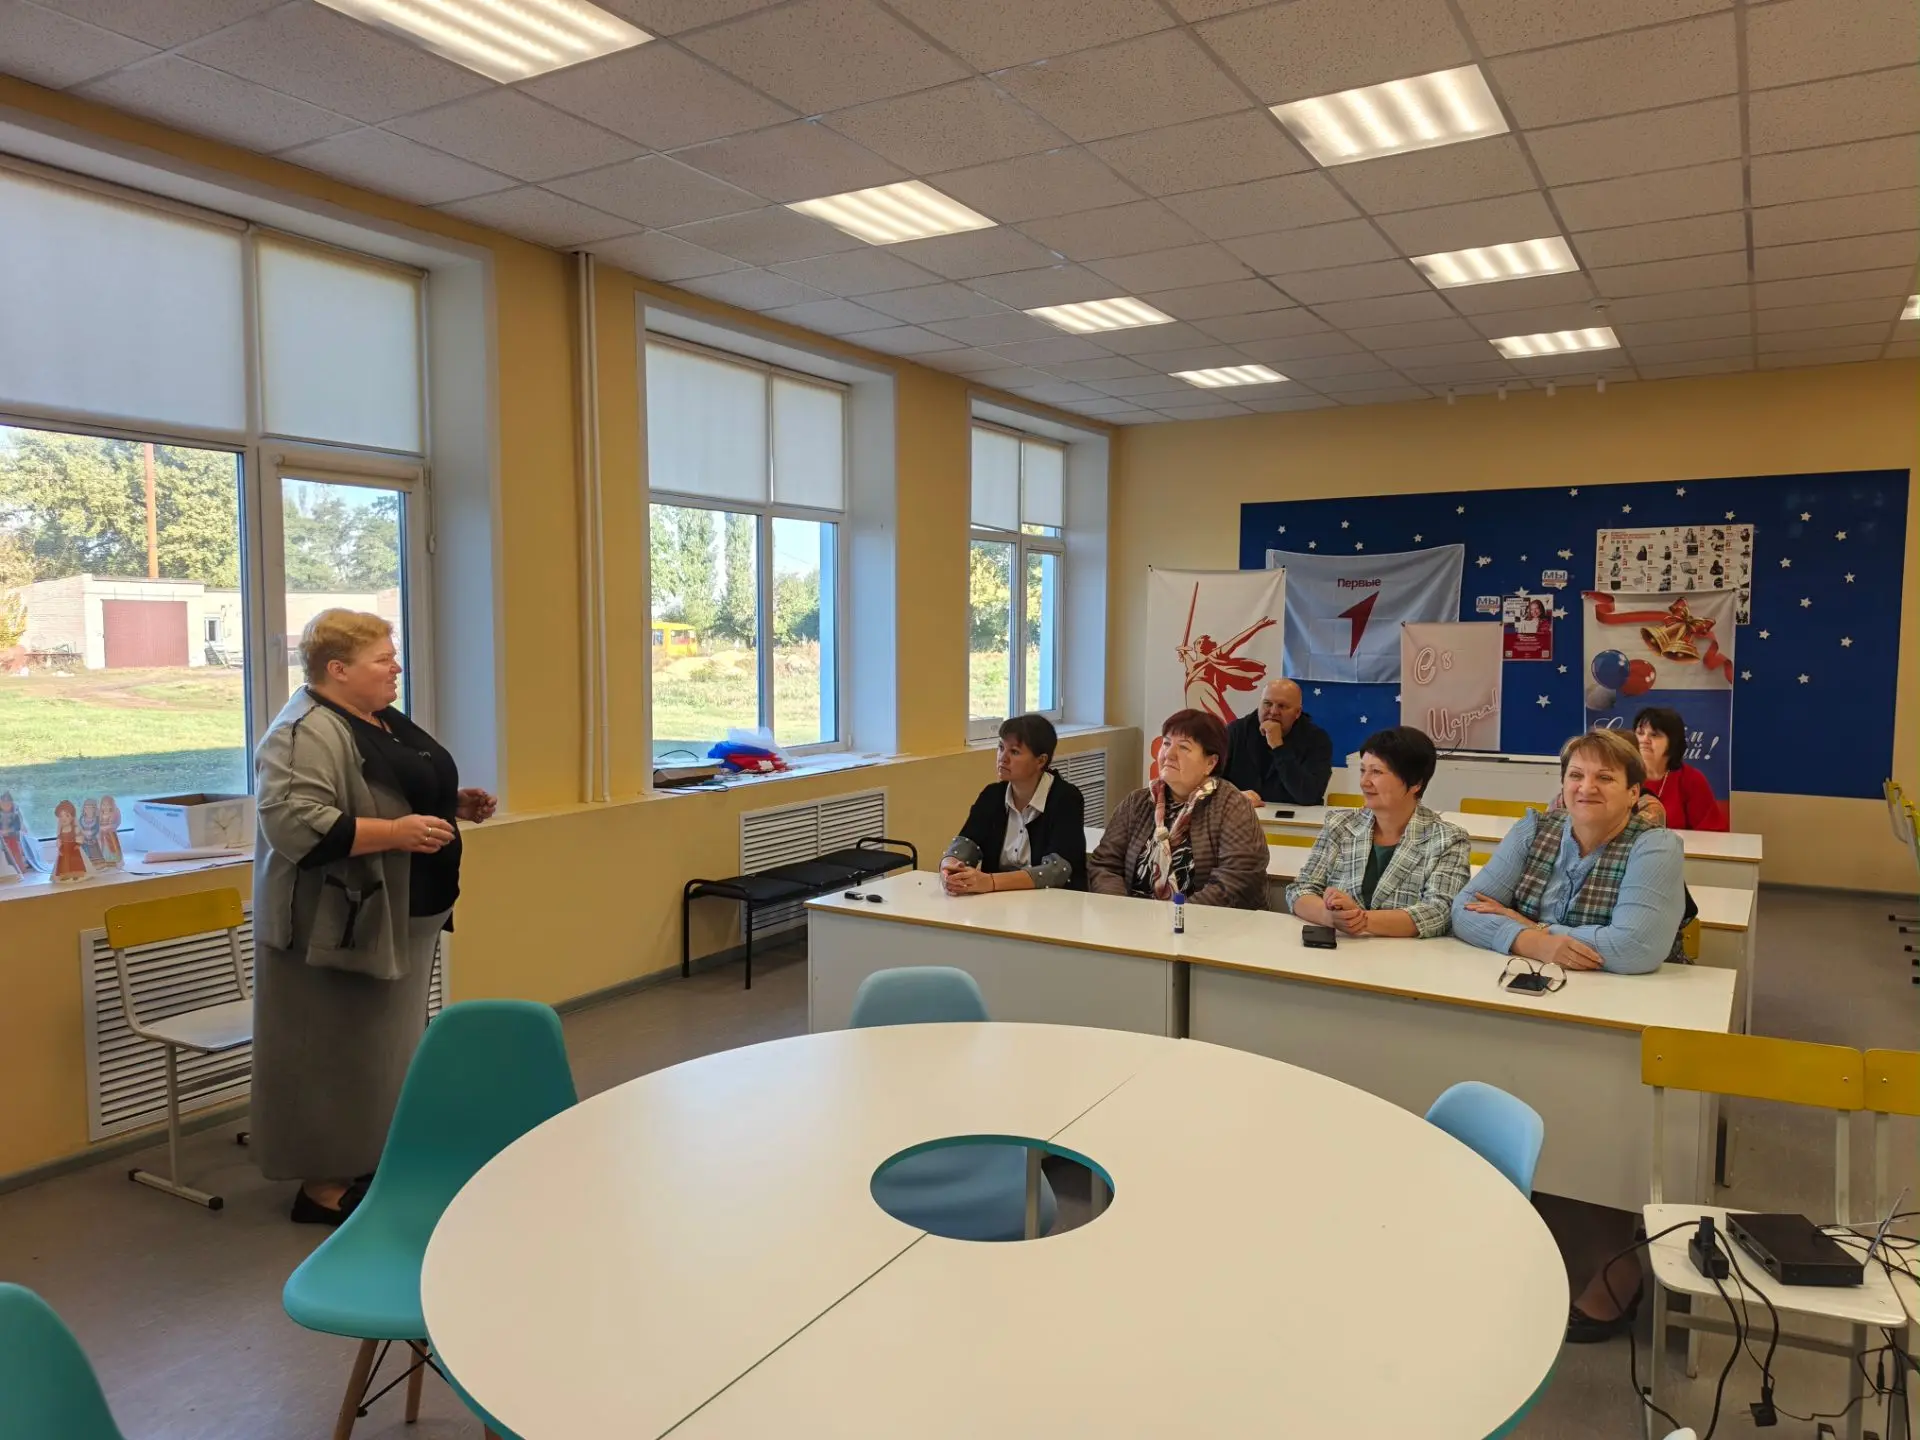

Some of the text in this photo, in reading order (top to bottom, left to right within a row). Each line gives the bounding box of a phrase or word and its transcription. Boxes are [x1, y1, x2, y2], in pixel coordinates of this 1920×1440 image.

[1337, 578, 1381, 590] Первые
[1414, 647, 1453, 684] С 8
